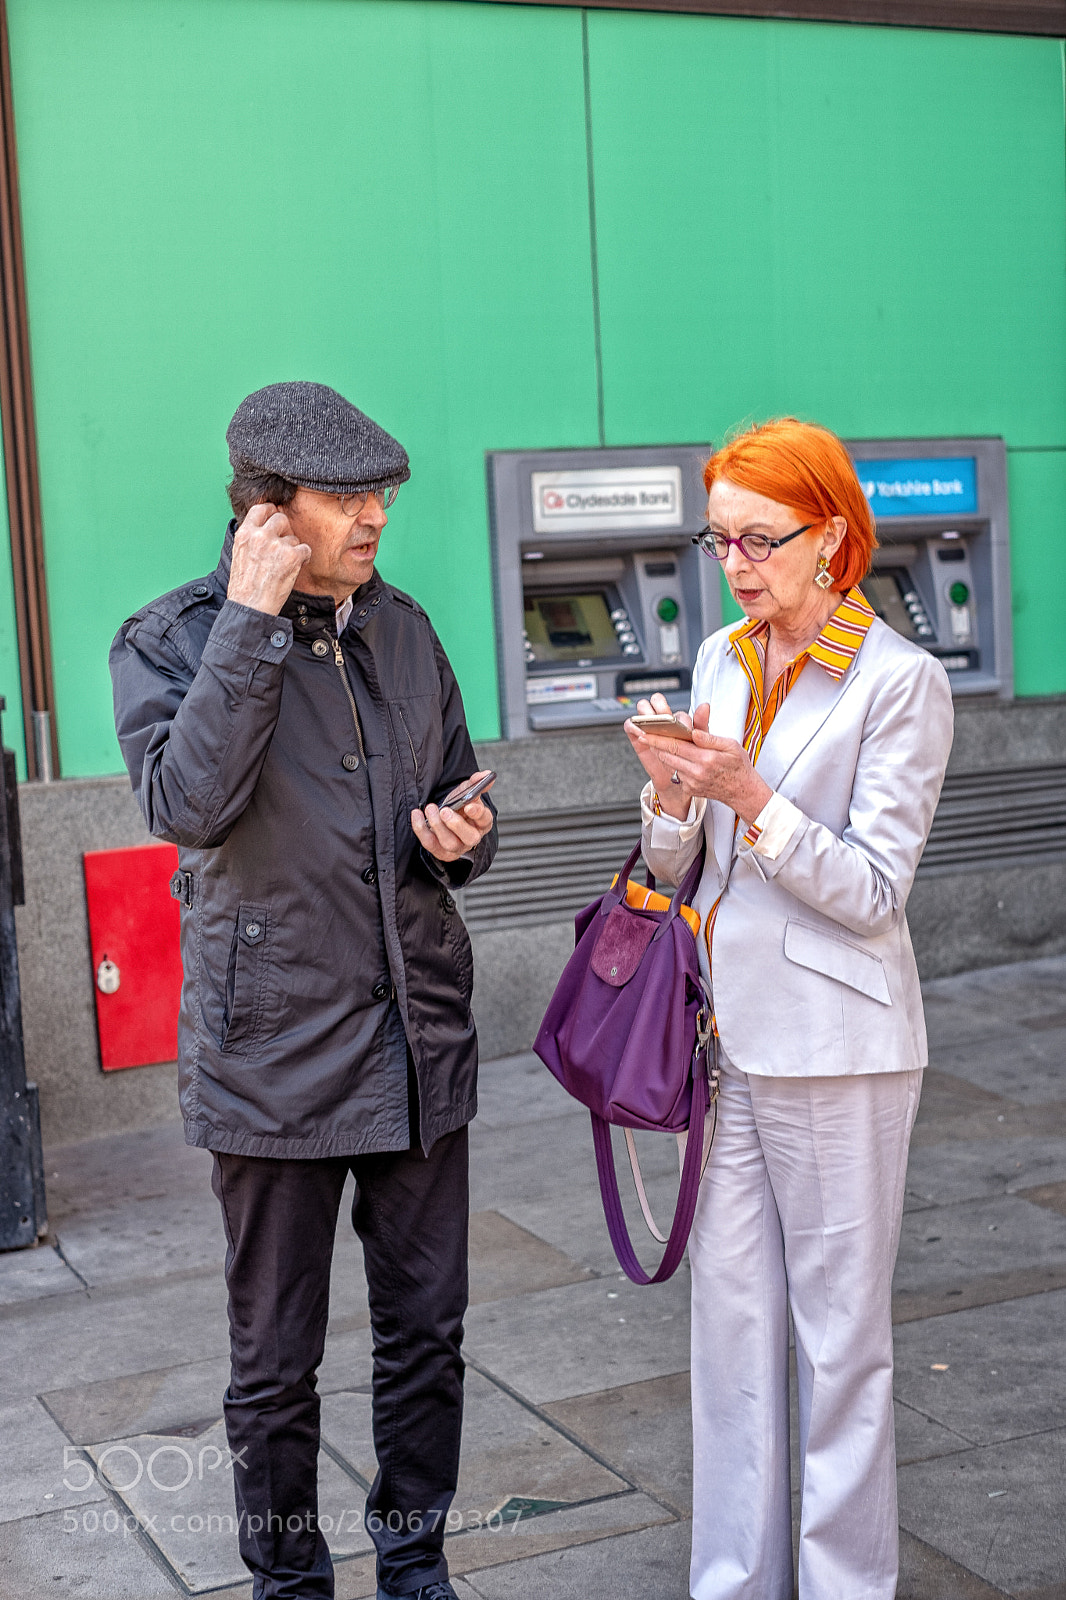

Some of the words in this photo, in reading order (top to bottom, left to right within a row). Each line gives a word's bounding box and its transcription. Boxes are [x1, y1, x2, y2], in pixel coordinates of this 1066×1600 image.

[877, 480, 931, 496] Yorkshire
[932, 479, 962, 495] Bank
[566, 492, 637, 509] Clydesdale
[640, 490, 669, 505] Bank
